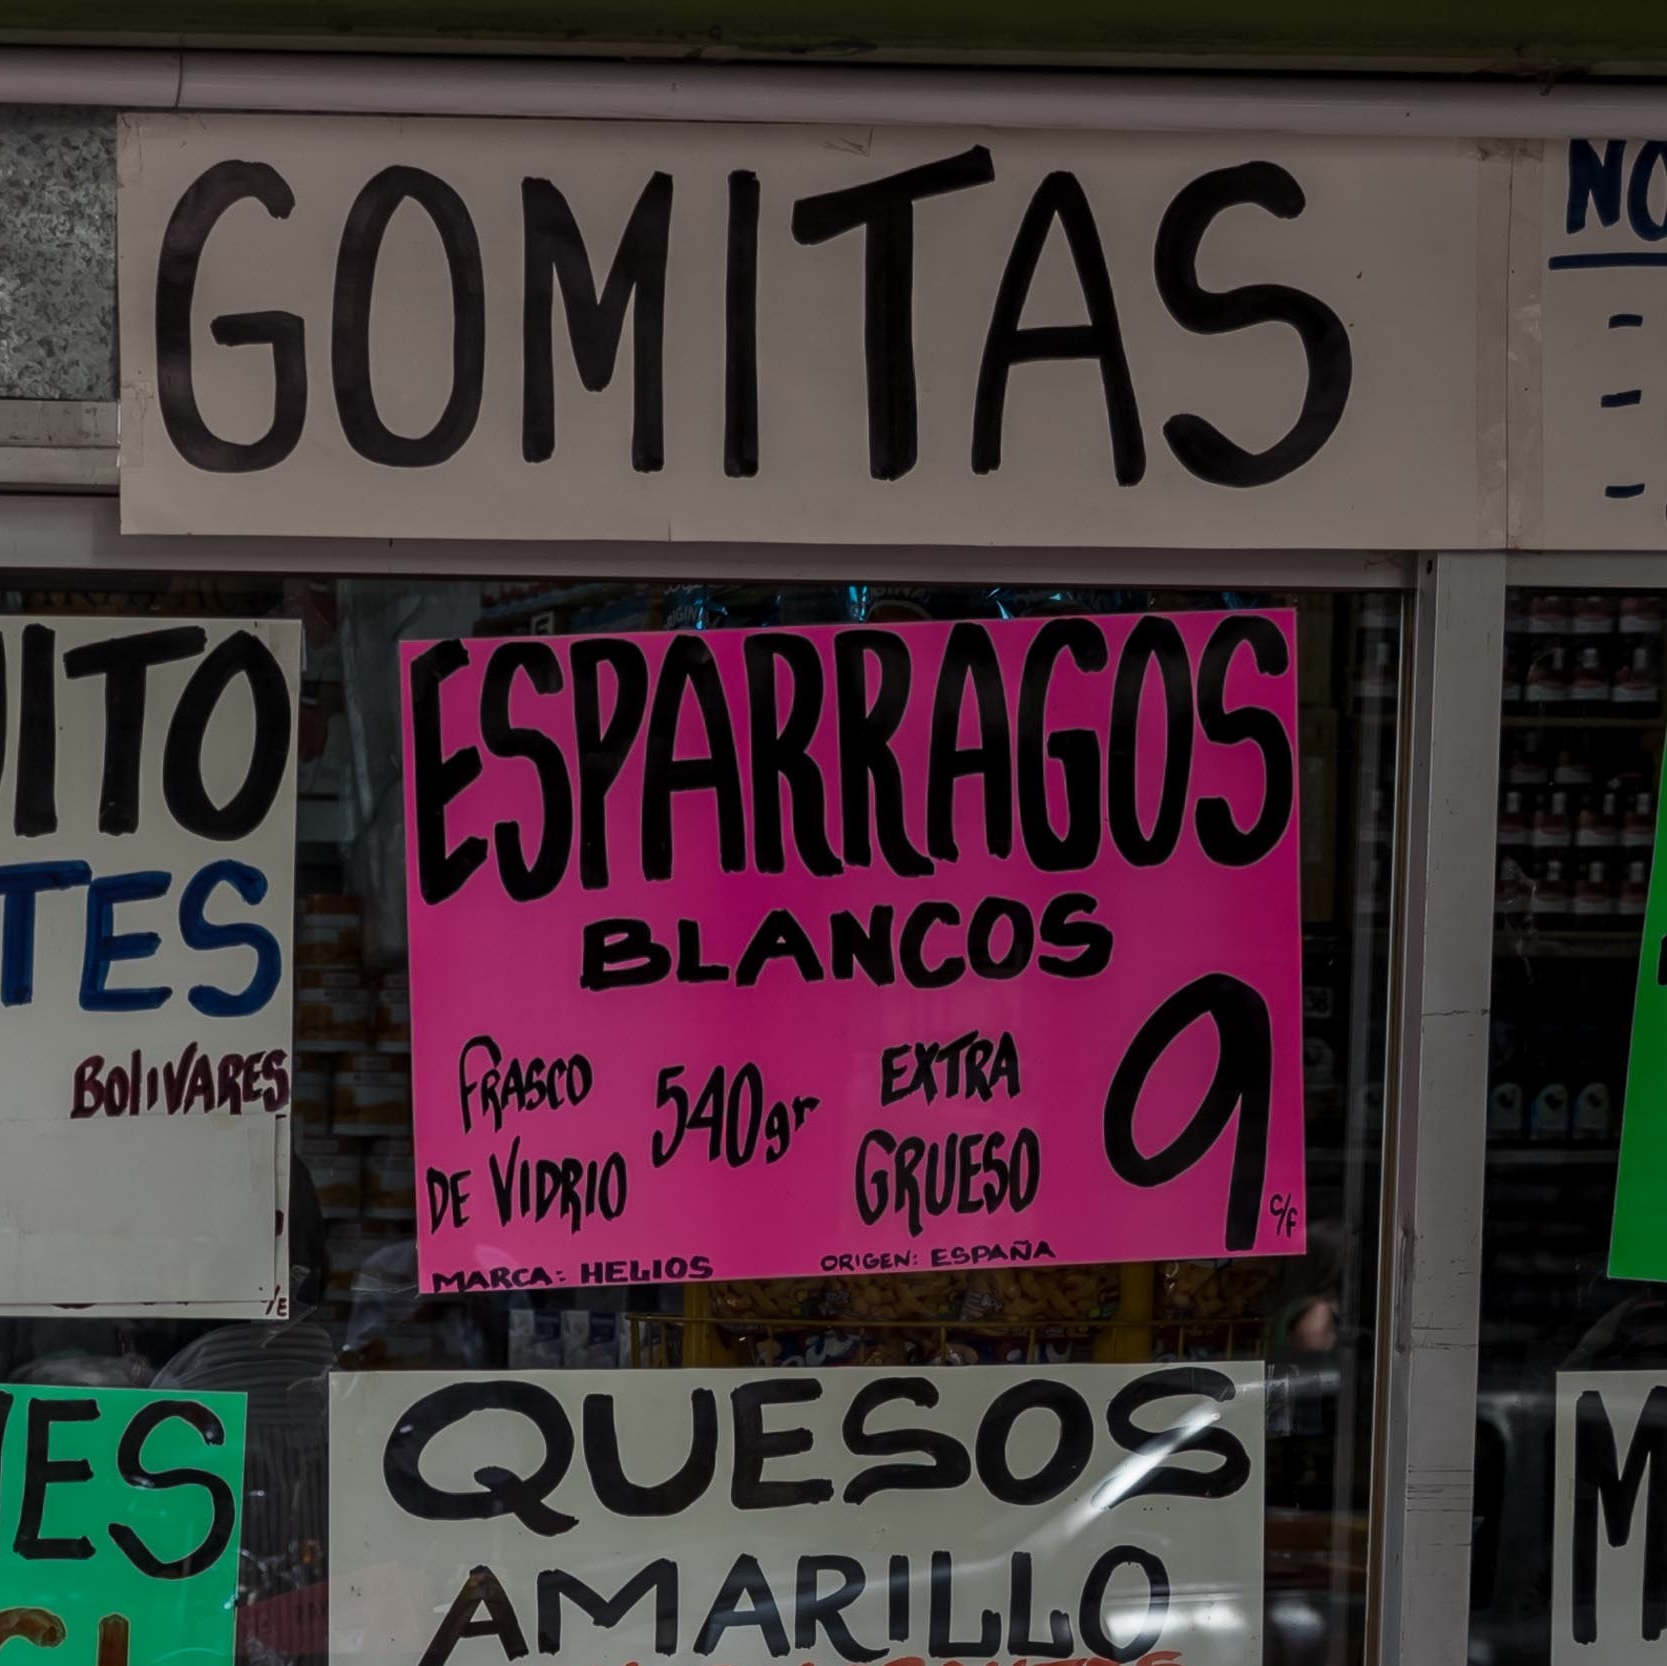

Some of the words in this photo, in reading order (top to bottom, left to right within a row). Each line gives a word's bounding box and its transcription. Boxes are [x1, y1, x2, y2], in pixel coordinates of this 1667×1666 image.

[155, 143, 1353, 488] GOMITAS
[409, 614, 1294, 906] ESPARRAGOS
[580, 892, 1114, 992] BLANCOS
[426, 1167, 472, 1234] DE
[489, 1136, 628, 1233] VIDRIO
[855, 1127, 1041, 1237] GRUESO
[459, 1035, 593, 1133] FRASCO
[880, 1029, 1021, 1107] EXTRA
[1103, 972, 1273, 1252] 9
[431, 1268, 567, 1294] MARCA:
[580, 1255, 713, 1284] HELIOS
[820, 1251, 921, 1272] ORIGEN:
[930, 1240, 1056, 1267] ESPAÑA
[383, 1366, 1252, 1537] QUESOS
